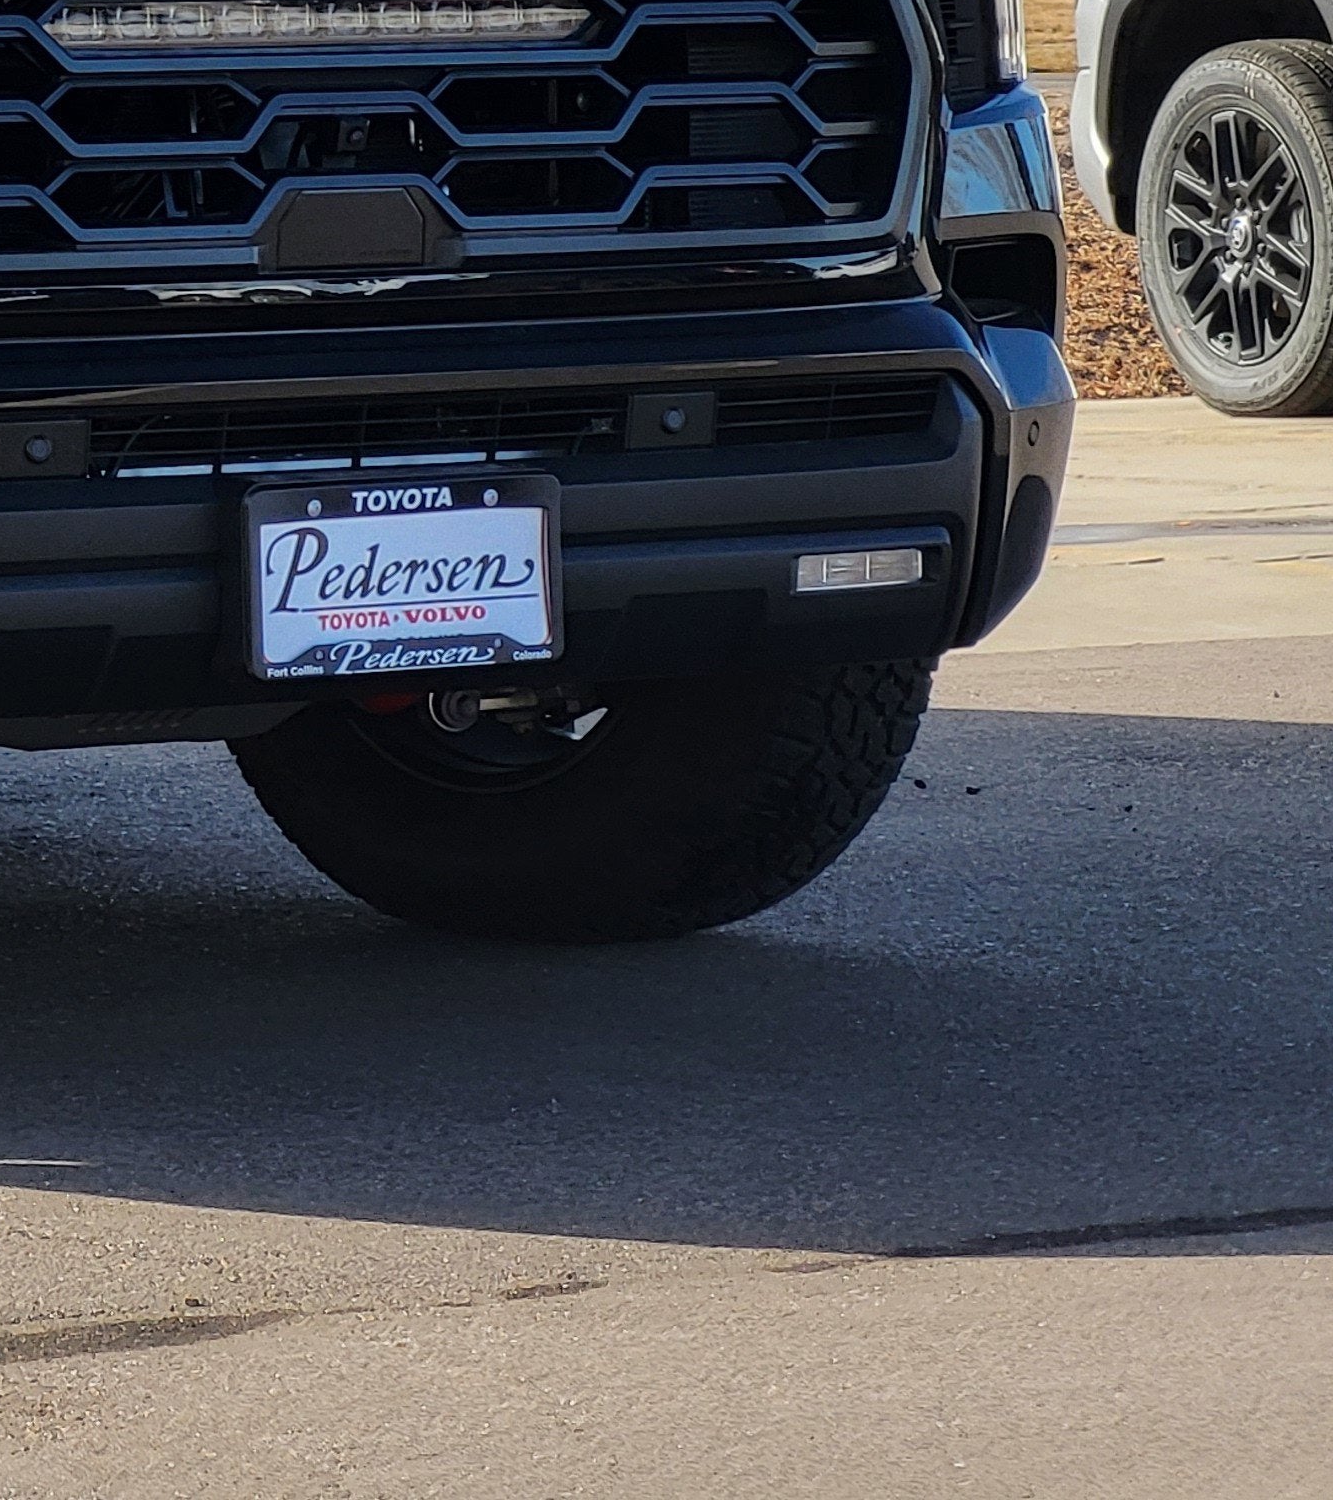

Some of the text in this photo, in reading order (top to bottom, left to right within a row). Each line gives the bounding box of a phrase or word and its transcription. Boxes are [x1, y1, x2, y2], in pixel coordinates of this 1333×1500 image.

[351, 486, 453, 513] TOYOTA
[265, 526, 535, 615] Pedersen
[318, 605, 486, 631] TOYOTA VOLVO
[329, 639, 495, 675] Pedersen
[513, 649, 553, 661] Colorado
[266, 664, 325, 679] Fort Collins
